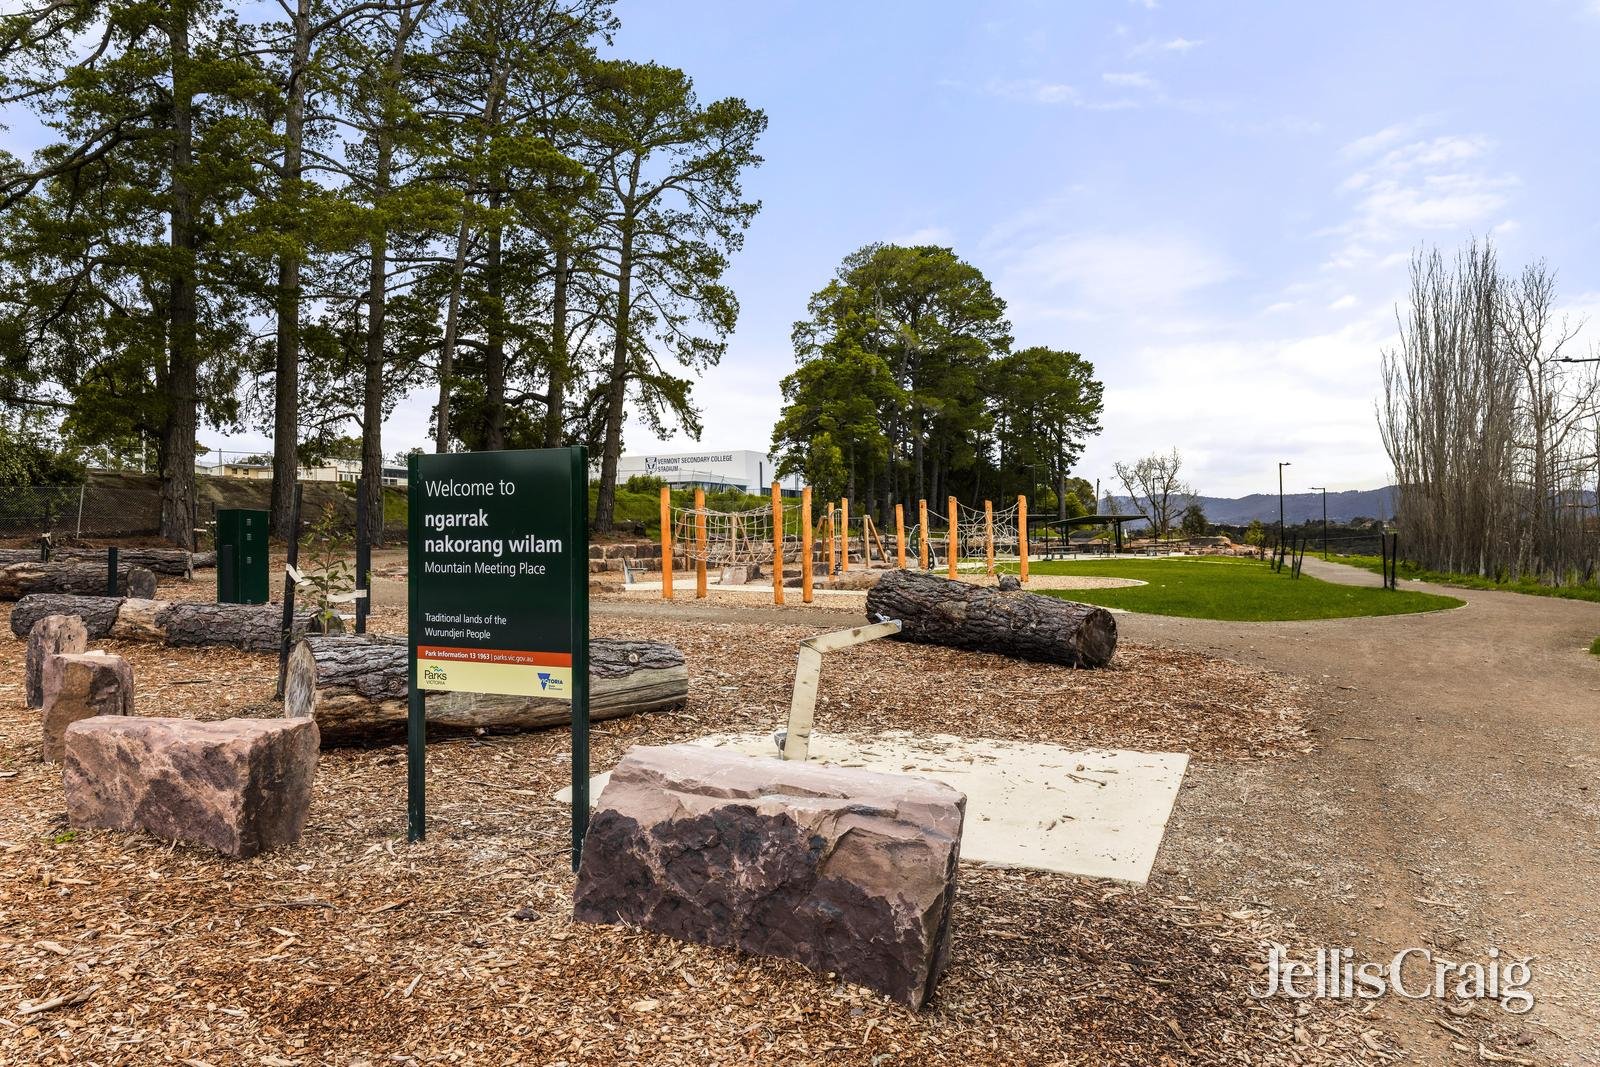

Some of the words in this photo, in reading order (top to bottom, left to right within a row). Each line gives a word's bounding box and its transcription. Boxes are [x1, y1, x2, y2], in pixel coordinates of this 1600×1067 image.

[681, 456, 710, 464] SECONDARY
[711, 455, 733, 463] COLLEGE
[425, 478, 494, 497] Welcome
[499, 479, 516, 496] to
[424, 508, 489, 532] ngarrak
[424, 534, 503, 557] nakorang
[508, 534, 562, 553] wilam
[424, 561, 472, 574] Mountain
[474, 561, 516, 577] Meeting
[519, 561, 546, 575] Place
[425, 613, 462, 623] Traditional
[463, 614, 483, 624] lands
[484, 615, 493, 625] of
[494, 615, 507, 625] the
[424, 628, 465, 640] Wurundjeri
[466, 629, 491, 641] People
[437, 651, 469, 659] Information
[477, 652, 490, 660] 1963
[493, 654, 534, 663] parks.vic.gov.au
[424, 670, 447, 681] Parks
